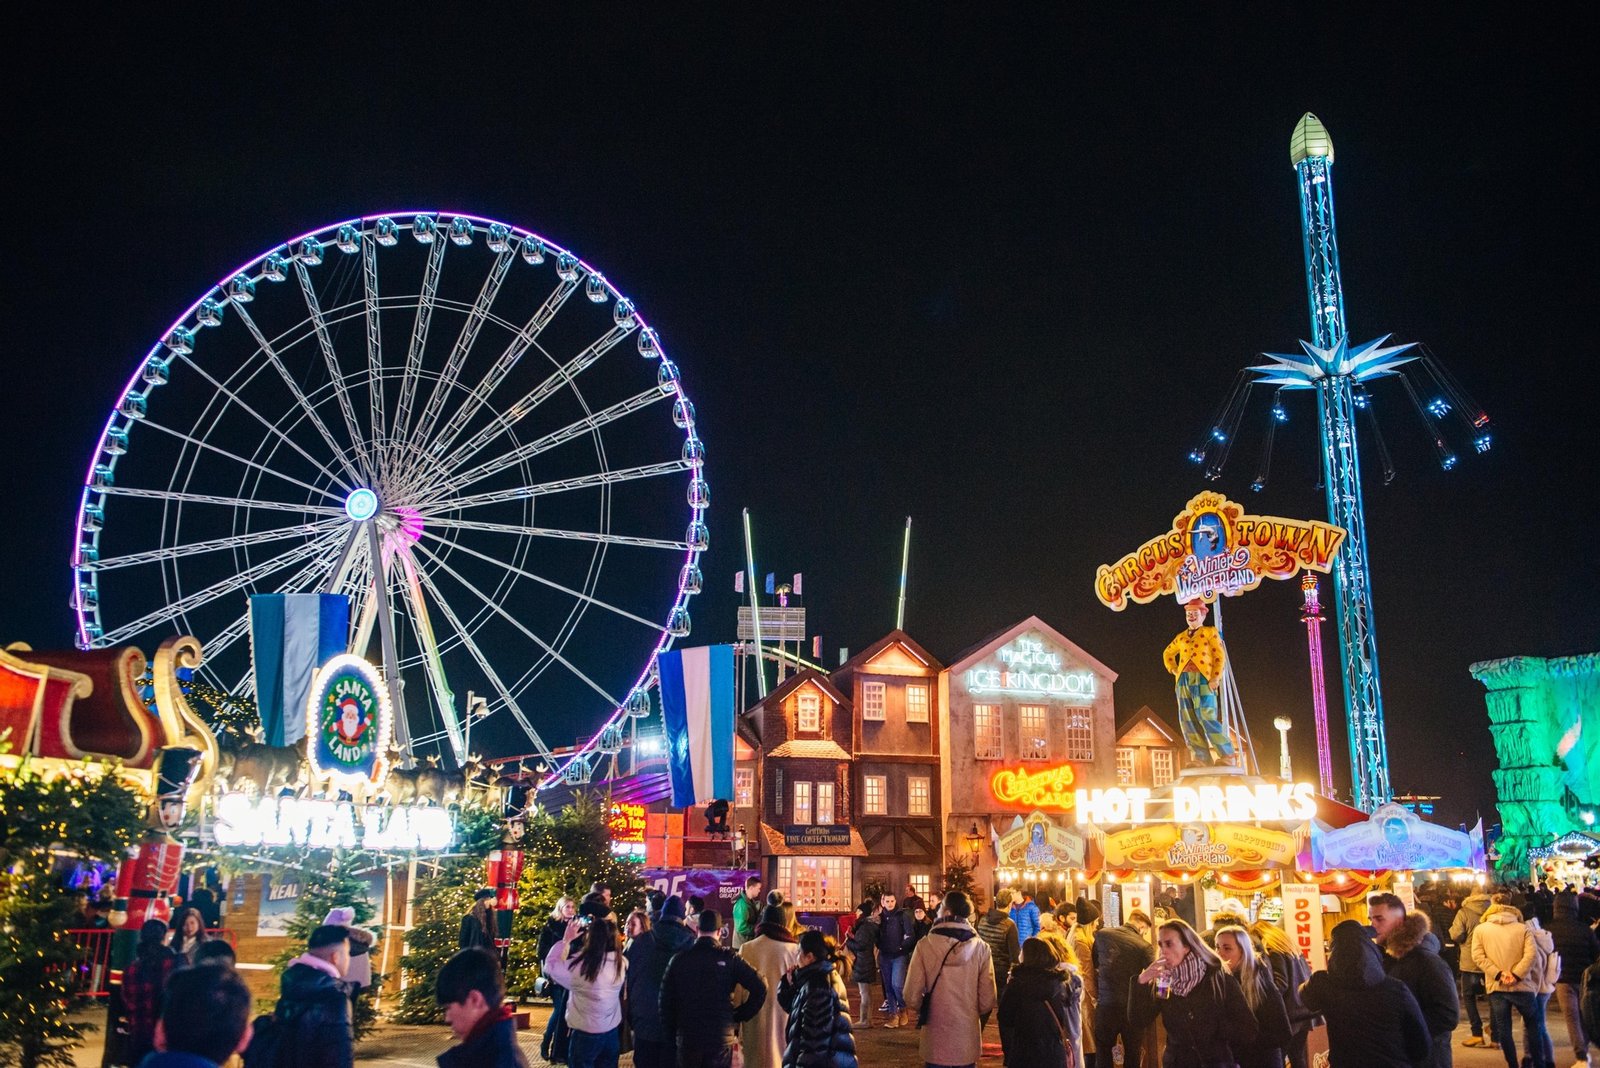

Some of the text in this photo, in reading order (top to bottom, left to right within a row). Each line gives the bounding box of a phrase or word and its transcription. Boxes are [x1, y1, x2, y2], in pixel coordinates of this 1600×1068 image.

[1100, 520, 1341, 603] CIRCUS TOWN
[1002, 650, 1060, 670] MAGICAL
[969, 670, 1095, 693] ICE KINGDOM
[336, 680, 372, 712] SANTA
[328, 736, 361, 762] LAND
[1032, 788, 1077, 809] CARO
[1075, 782, 1317, 824] HOT DRINKS
[213, 792, 356, 849] SANTA
[786, 835, 800, 843] FINE
[1118, 833, 1152, 850] LATTE
[269, 883, 298, 901] REAL
